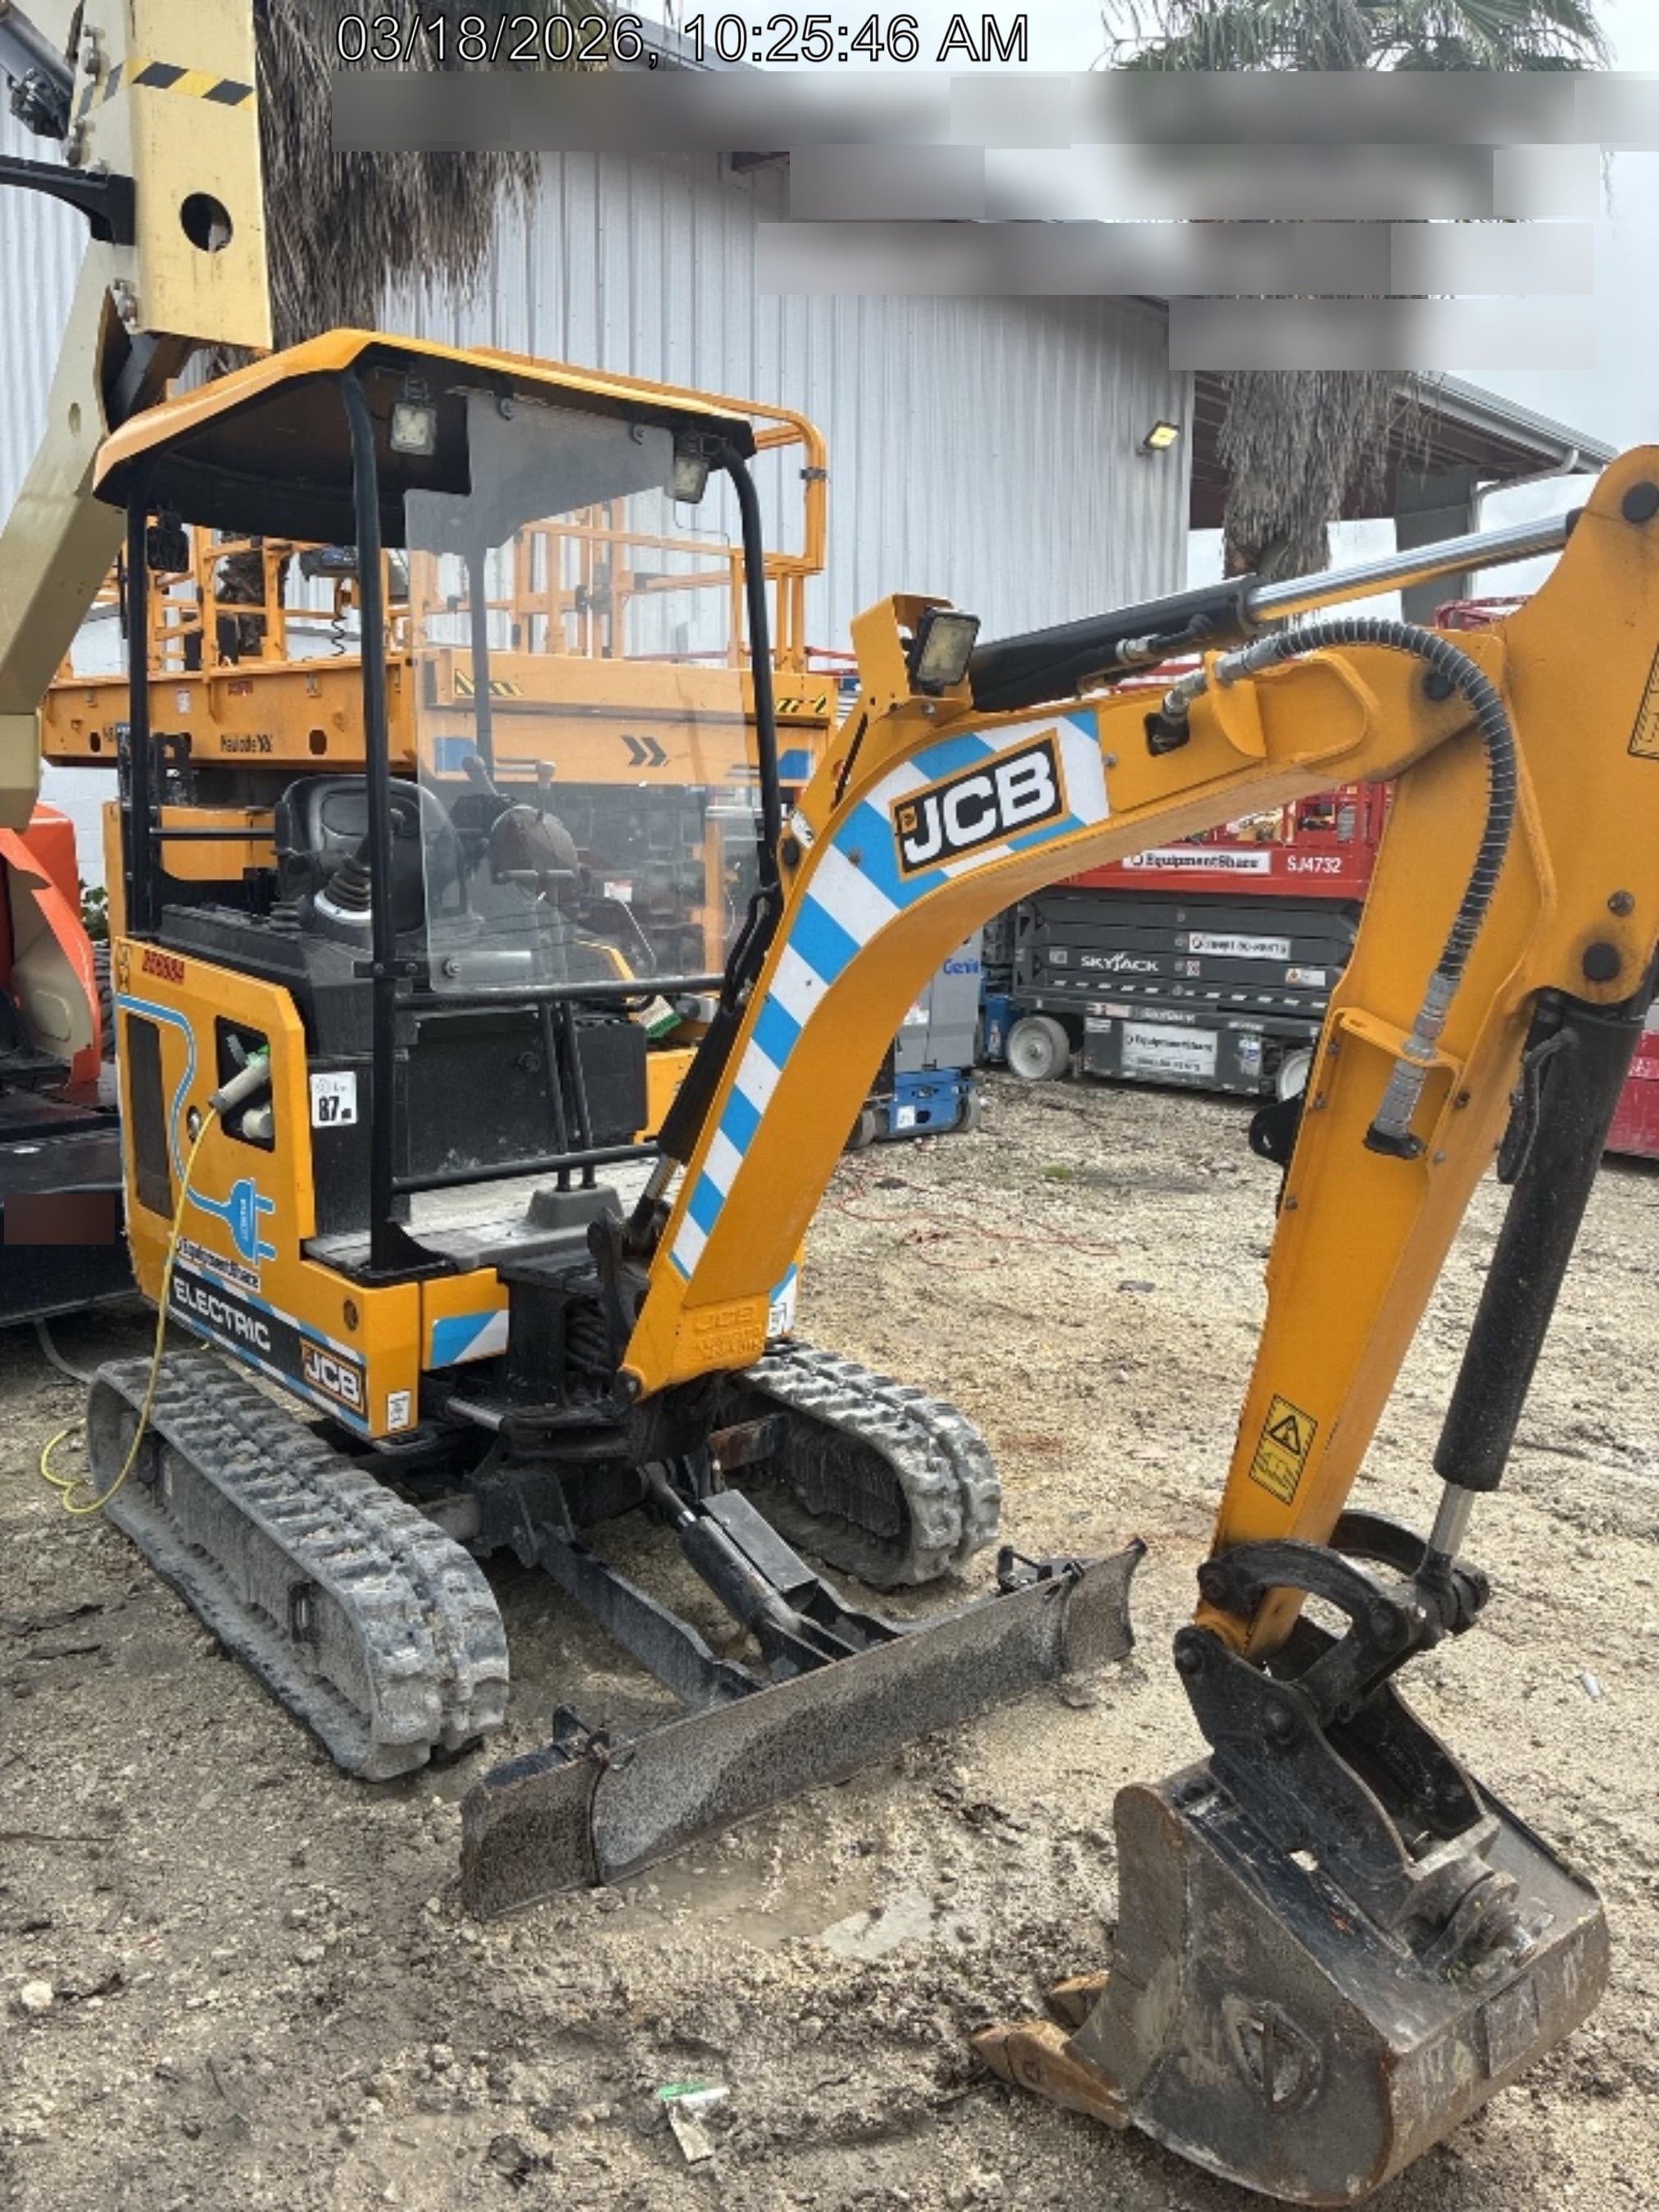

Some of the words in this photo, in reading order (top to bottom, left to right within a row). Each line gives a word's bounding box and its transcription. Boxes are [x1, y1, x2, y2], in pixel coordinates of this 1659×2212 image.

[903, 750, 1055, 863] JCB
[1146, 853, 1259, 868] EquipmentShare
[1287, 855, 1342, 873] SJ4732
[1081, 951, 1159, 972] SKYJACK
[319, 1095, 339, 1121] 87
[174, 1277, 270, 1352] ELECTRIC
[306, 1352, 360, 1403] JCB
